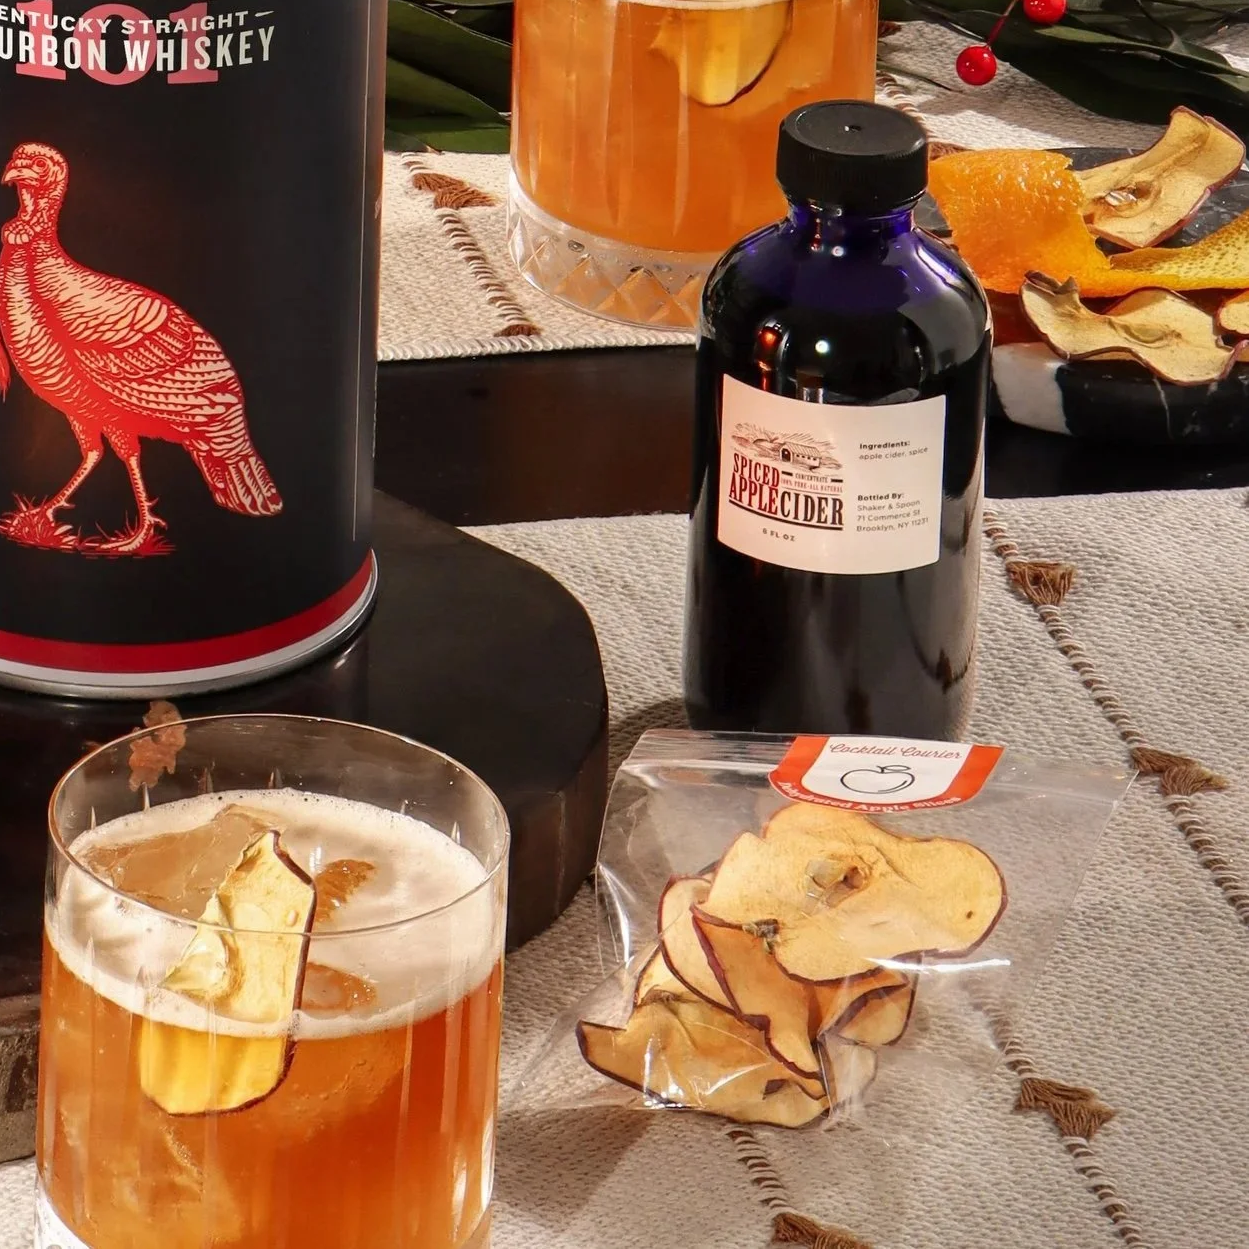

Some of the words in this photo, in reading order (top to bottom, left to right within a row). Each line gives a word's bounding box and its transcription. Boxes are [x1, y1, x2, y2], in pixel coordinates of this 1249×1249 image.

[121, 10, 249, 36] STRAIGHT
[124, 26, 275, 72] WHISKEY
[859, 441, 910, 450] Ingredients:
[909, 447, 928, 456] spice
[733, 452, 779, 488] SPICED
[729, 472, 779, 515] APPLE
[780, 491, 844, 525] CIDER
[858, 493, 890, 501] Bottled
[896, 500, 920, 509] Spoon
[868, 512, 910, 521] Commerce
[856, 524, 895, 532] Brooklyn,
[829, 743, 895, 756] Cocktail
[901, 747, 962, 759] Courier
